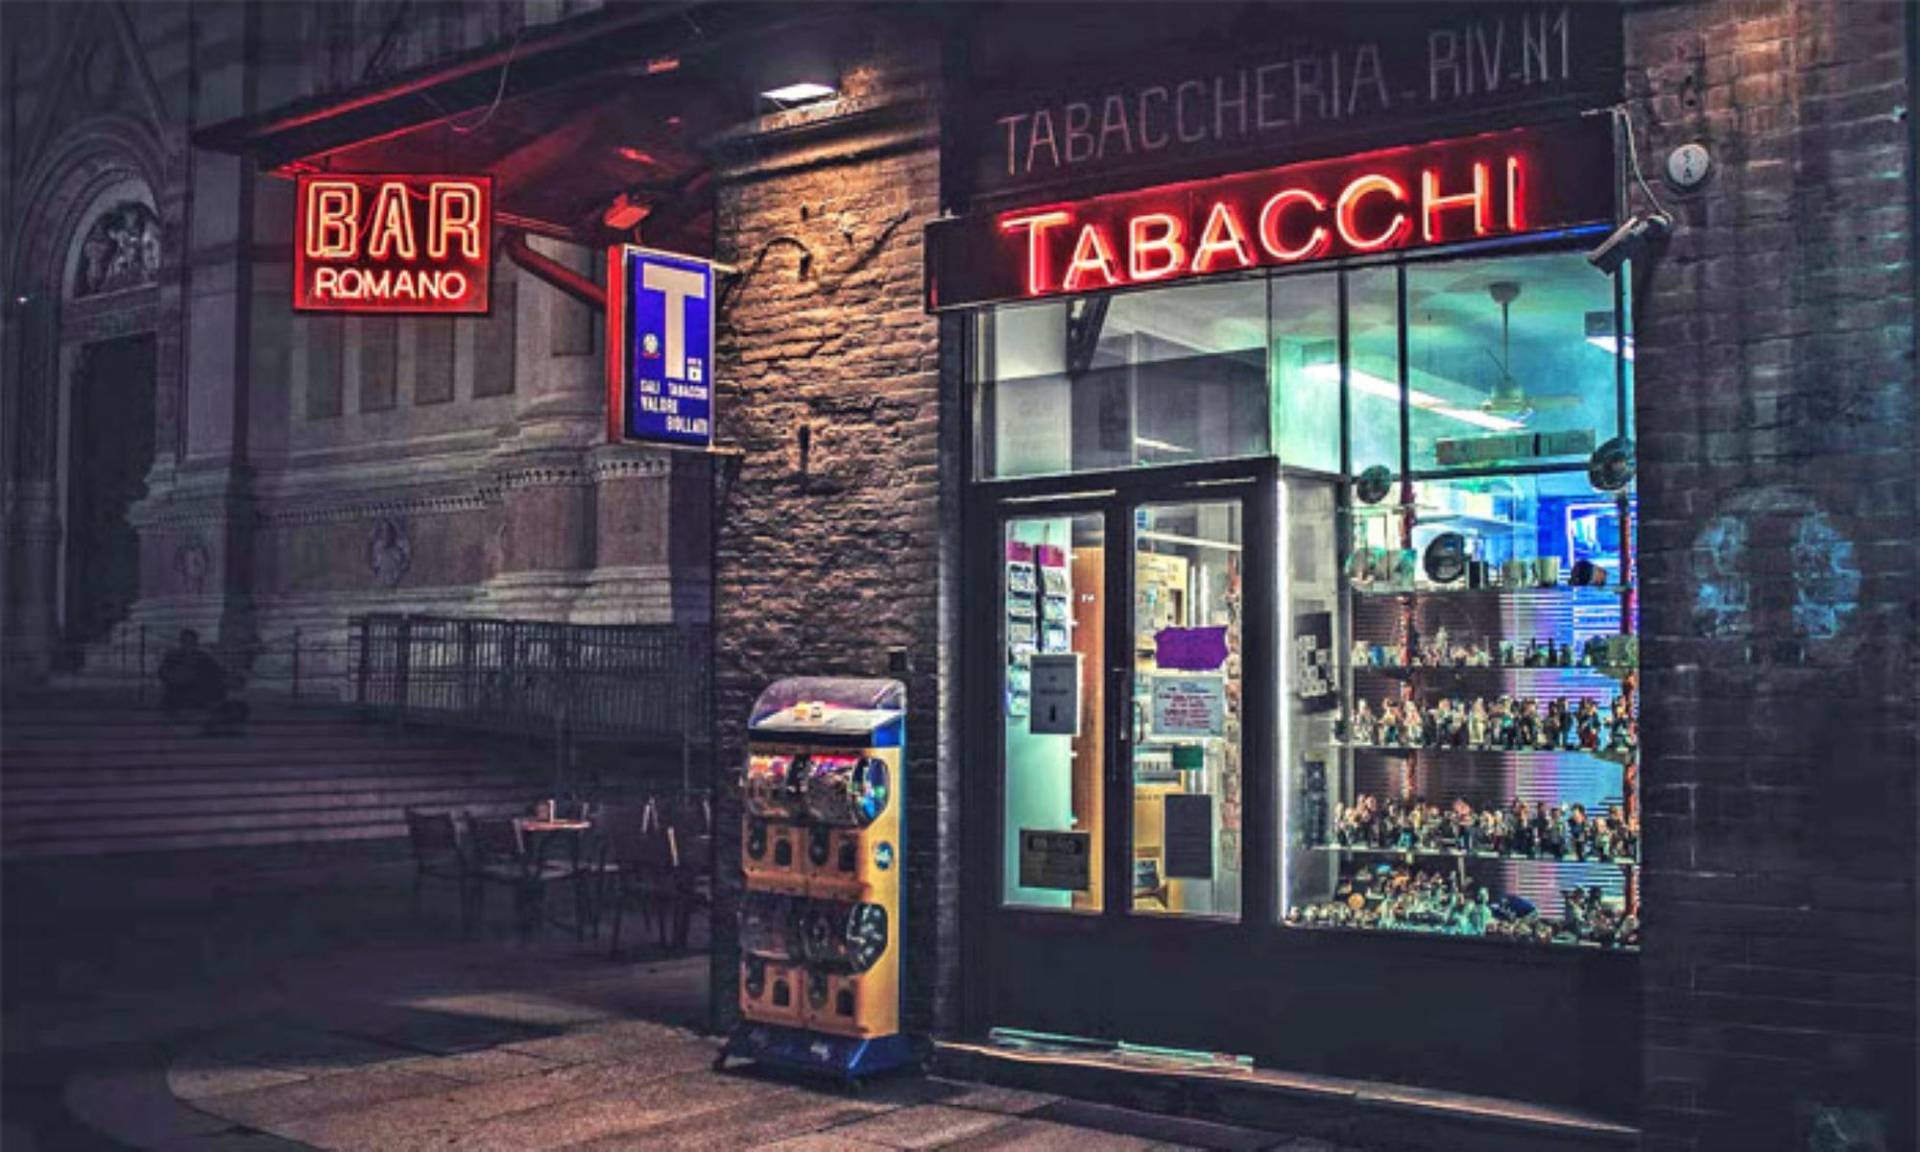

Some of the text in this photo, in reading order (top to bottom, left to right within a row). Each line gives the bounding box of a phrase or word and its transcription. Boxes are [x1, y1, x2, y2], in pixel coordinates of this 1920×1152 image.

[997, 43, 1389, 175] TABACCHERIA
[305, 181, 481, 259] BAR
[1001, 156, 1526, 295] TABACCHI
[315, 267, 467, 299] ROMANO
[643, 262, 706, 380] T
